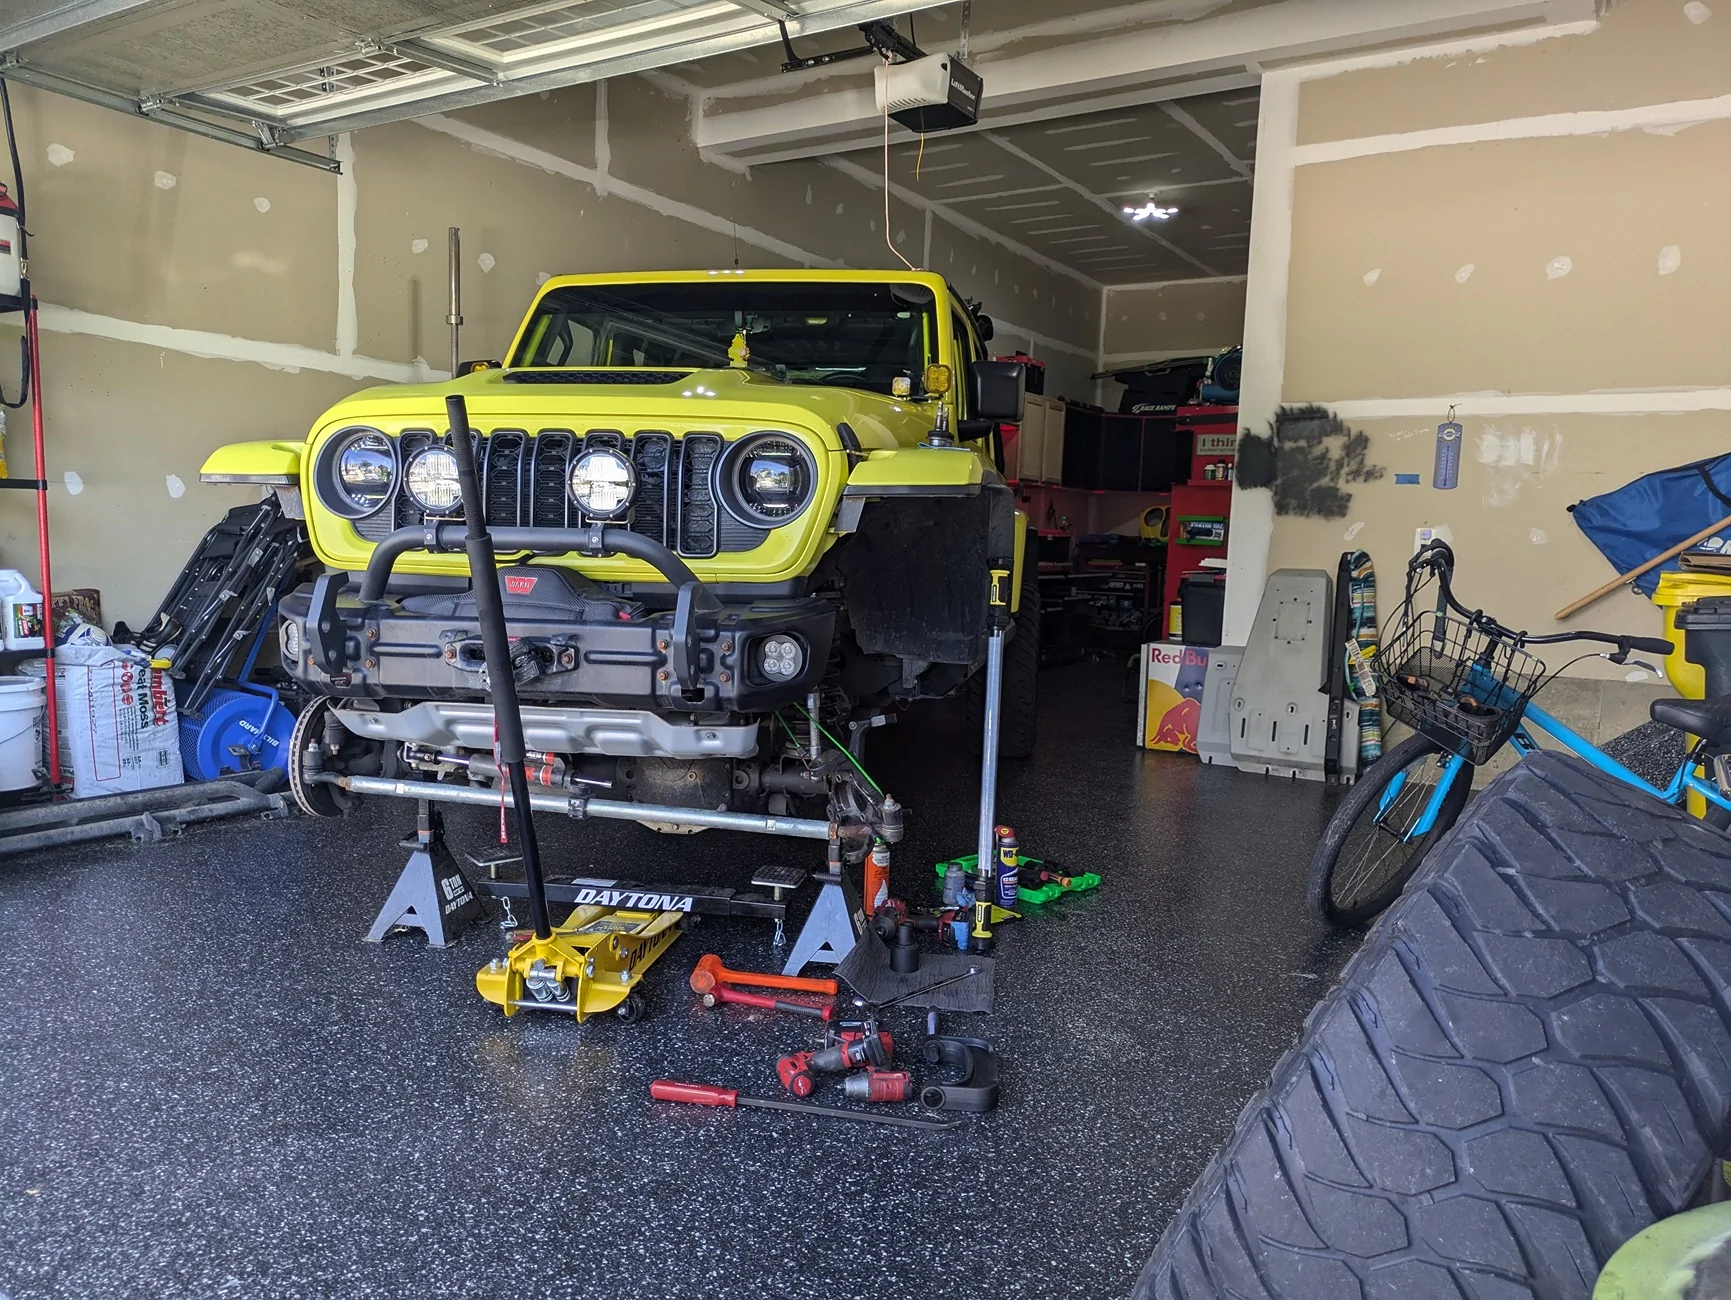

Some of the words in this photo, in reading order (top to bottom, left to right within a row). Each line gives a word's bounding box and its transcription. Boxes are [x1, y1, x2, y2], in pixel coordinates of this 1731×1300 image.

[509, 581, 531, 589] WARN
[1151, 647, 1183, 664] Red
[1185, 650, 1208, 668] Bu
[136, 667, 147, 690] eat
[151, 668, 169, 727] ambert
[138, 692, 149, 729] Moss
[441, 878, 454, 901] 6
[573, 888, 693, 912] DAYTONA
[445, 891, 474, 915] DAYTONA
